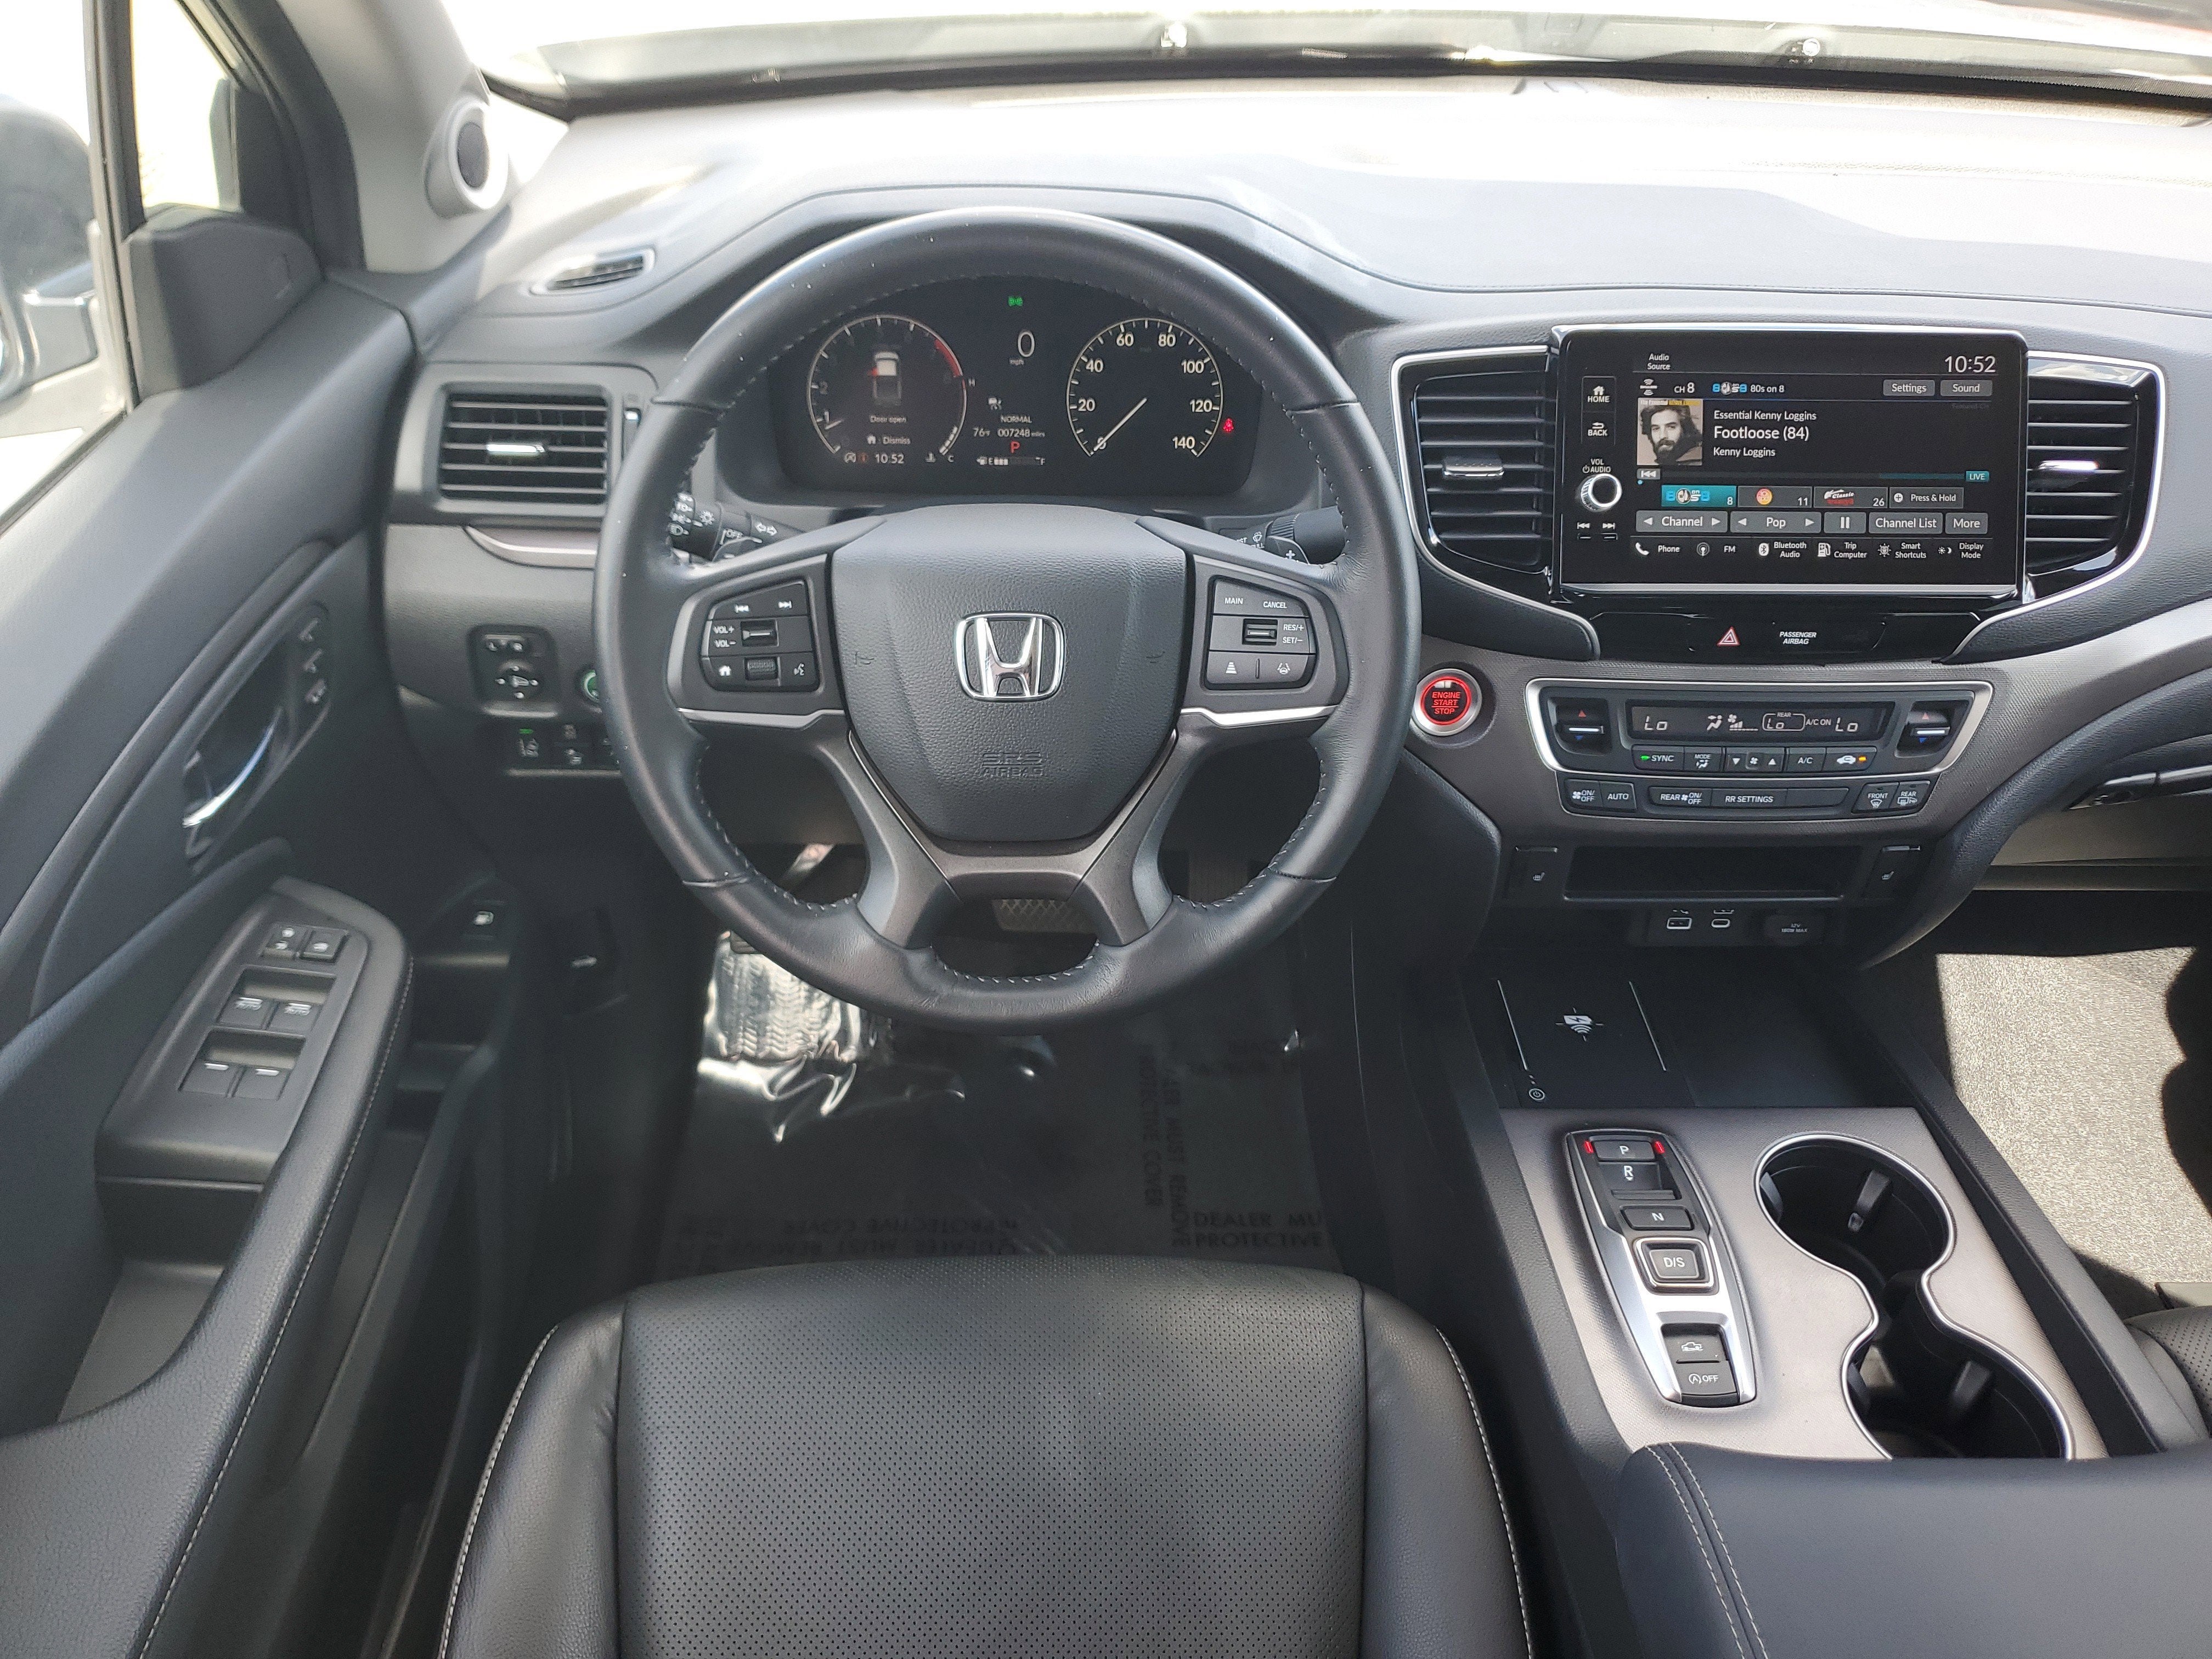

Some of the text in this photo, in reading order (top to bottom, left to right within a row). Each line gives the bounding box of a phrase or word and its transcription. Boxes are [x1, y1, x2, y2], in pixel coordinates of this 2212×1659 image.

[1018, 331, 1035, 357] 0
[1116, 332, 1134, 347] 60
[1158, 332, 1176, 347] 80
[1086, 358, 1104, 373] 40
[1181, 358, 1205, 374] 100
[1647, 362, 1671, 370] Source
[1944, 356, 1996, 373] 10:52
[1674, 382, 1695, 393] CH 8
[1750, 384, 1765, 393] 80s
[1779, 385, 1785, 393] 8
[1892, 383, 1927, 394] Settings
[1952, 383, 1980, 393] Sound
[1078, 397, 1096, 411] 20
[1189, 399, 1212, 413] 120
[1000, 414, 1032, 424] NORMAL
[1714, 410, 1817, 422] Essential Kenny Loggins
[997, 428, 1030, 437] 007248
[1714, 426, 1809, 441] Footloose (84)
[1010, 441, 1020, 454] P
[1172, 436, 1195, 449] 140
[1713, 447, 1776, 458] Kenny Loggins
[875, 453, 905, 464] 10:52
[1727, 496, 1734, 505] 8
[1798, 496, 1808, 506] 11
[1873, 498, 1885, 506] 26
[1661, 516, 1703, 527] Channel
[1766, 517, 1786, 528] Pop
[1876, 518, 1937, 528] Channel List
[1953, 519, 1980, 528] More
[1658, 545, 1680, 553] Phone
[1843, 541, 1857, 550] Trip
[1959, 543, 1984, 551] Display
[1834, 551, 1867, 560] Computer
[1895, 551, 1927, 559] Shortcuts
[1805, 718, 1831, 726] A/C ON
[1737, 795, 1774, 804] SETTINGS
[1619, 1145, 1629, 1155] P
[1624, 1165, 1633, 1177] R
[1652, 1212, 1664, 1222] N
[1663, 1256, 1685, 1268] D/S
